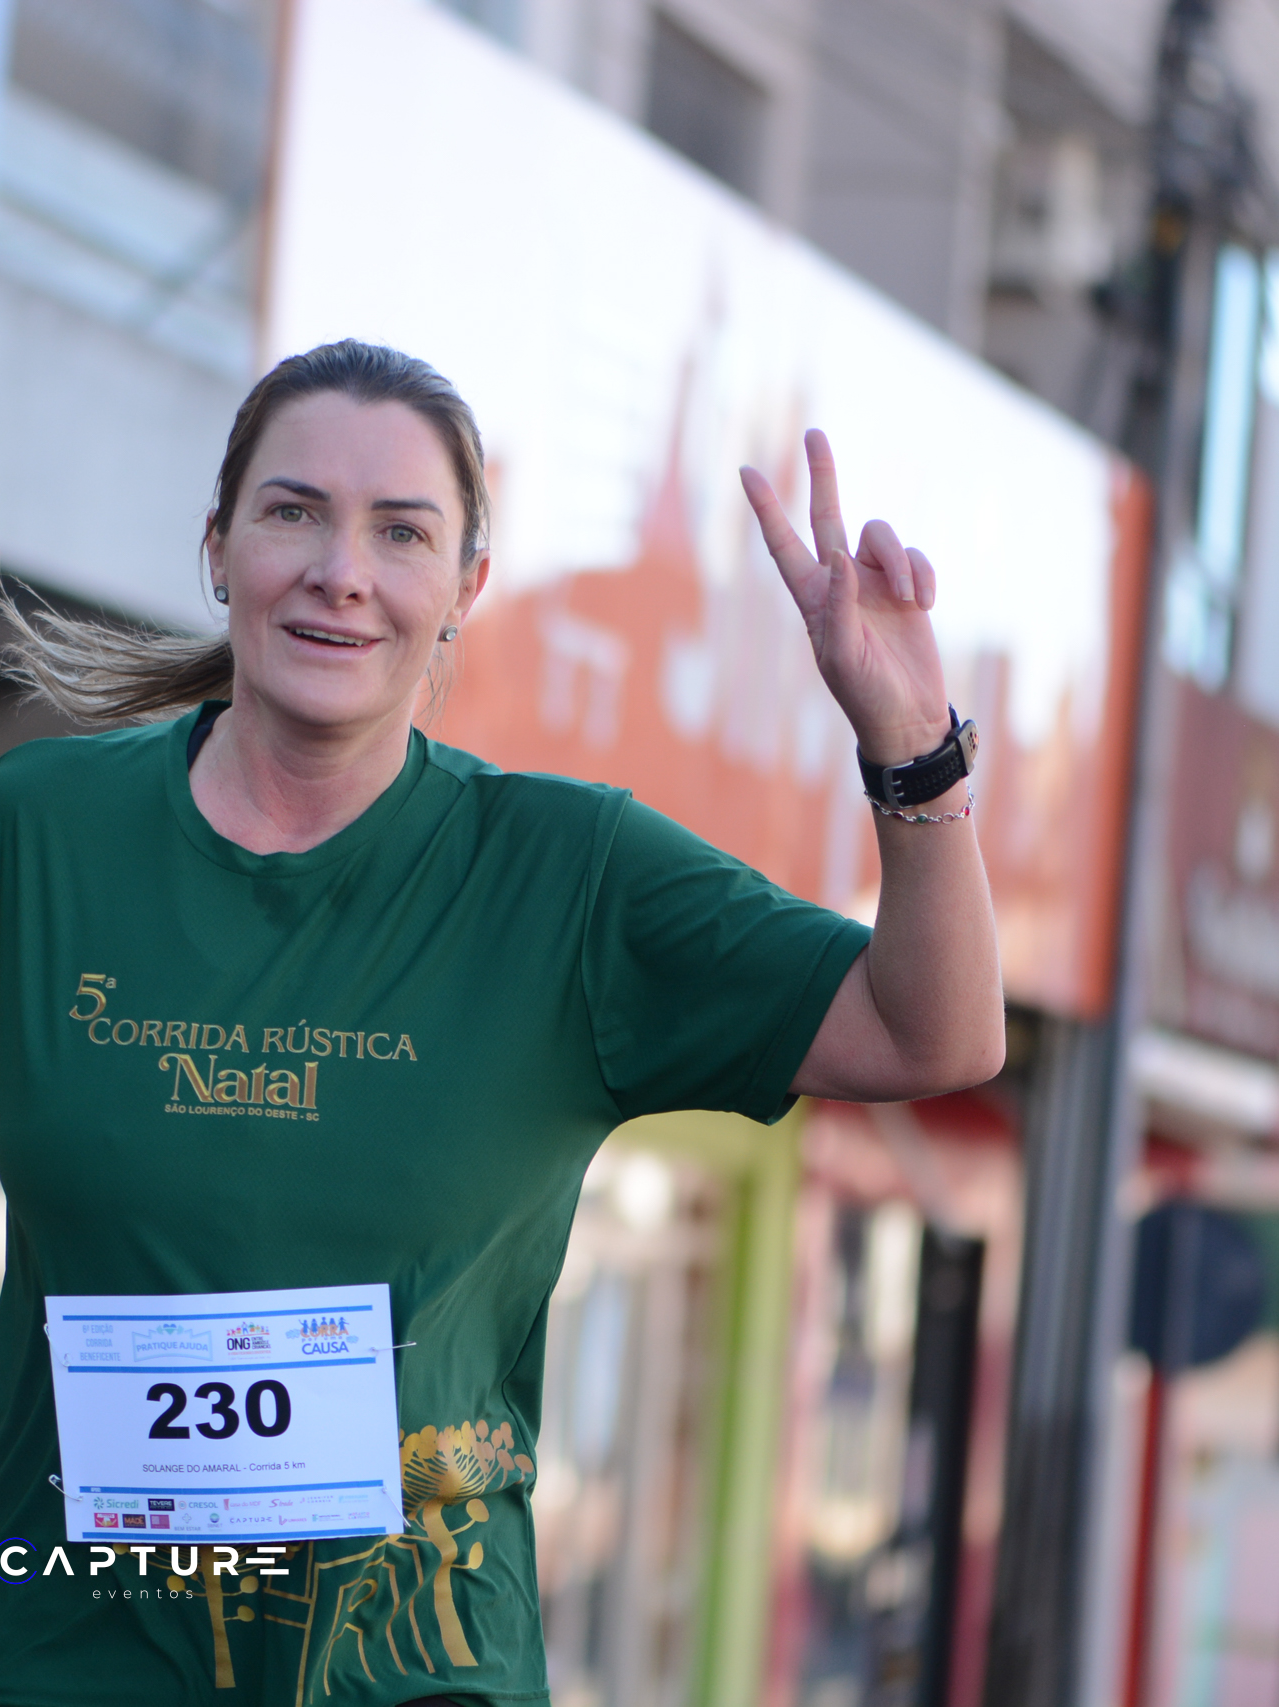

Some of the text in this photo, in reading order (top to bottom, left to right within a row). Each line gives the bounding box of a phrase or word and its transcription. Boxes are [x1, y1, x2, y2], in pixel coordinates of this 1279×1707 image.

[69, 973, 117, 1020] 5ª
[88, 1018, 418, 1061] CORRIDA RÚSTICA
[158, 1053, 319, 1109] Natal
[165, 1103, 186, 1113] SÃO
[189, 1106, 245, 1116] LOURENÇO
[248, 1107, 263, 1116] DO
[265, 1109, 298, 1120] OESTE
[306, 1113, 320, 1121] SC
[91, 1324, 113, 1335] EDIÇÃO
[300, 1324, 349, 1338] CORRA
[86, 1338, 113, 1347] CORRIDA
[136, 1341, 209, 1352] PRATIQUE AJUDA
[227, 1337, 250, 1351] ONG
[302, 1341, 350, 1355] CAUSA
[80, 1352, 121, 1362] BENEFICENTE
[146, 1379, 292, 1440] 230
[143, 1464, 184, 1473] SOLANGE
[187, 1464, 200, 1473] DO
[202, 1464, 241, 1472] AMARAL
[249, 1462, 281, 1471] Corrida
[284, 1461, 290, 1469] 5
[292, 1461, 305, 1469] km
[107, 1499, 139, 1509] Sicredi
